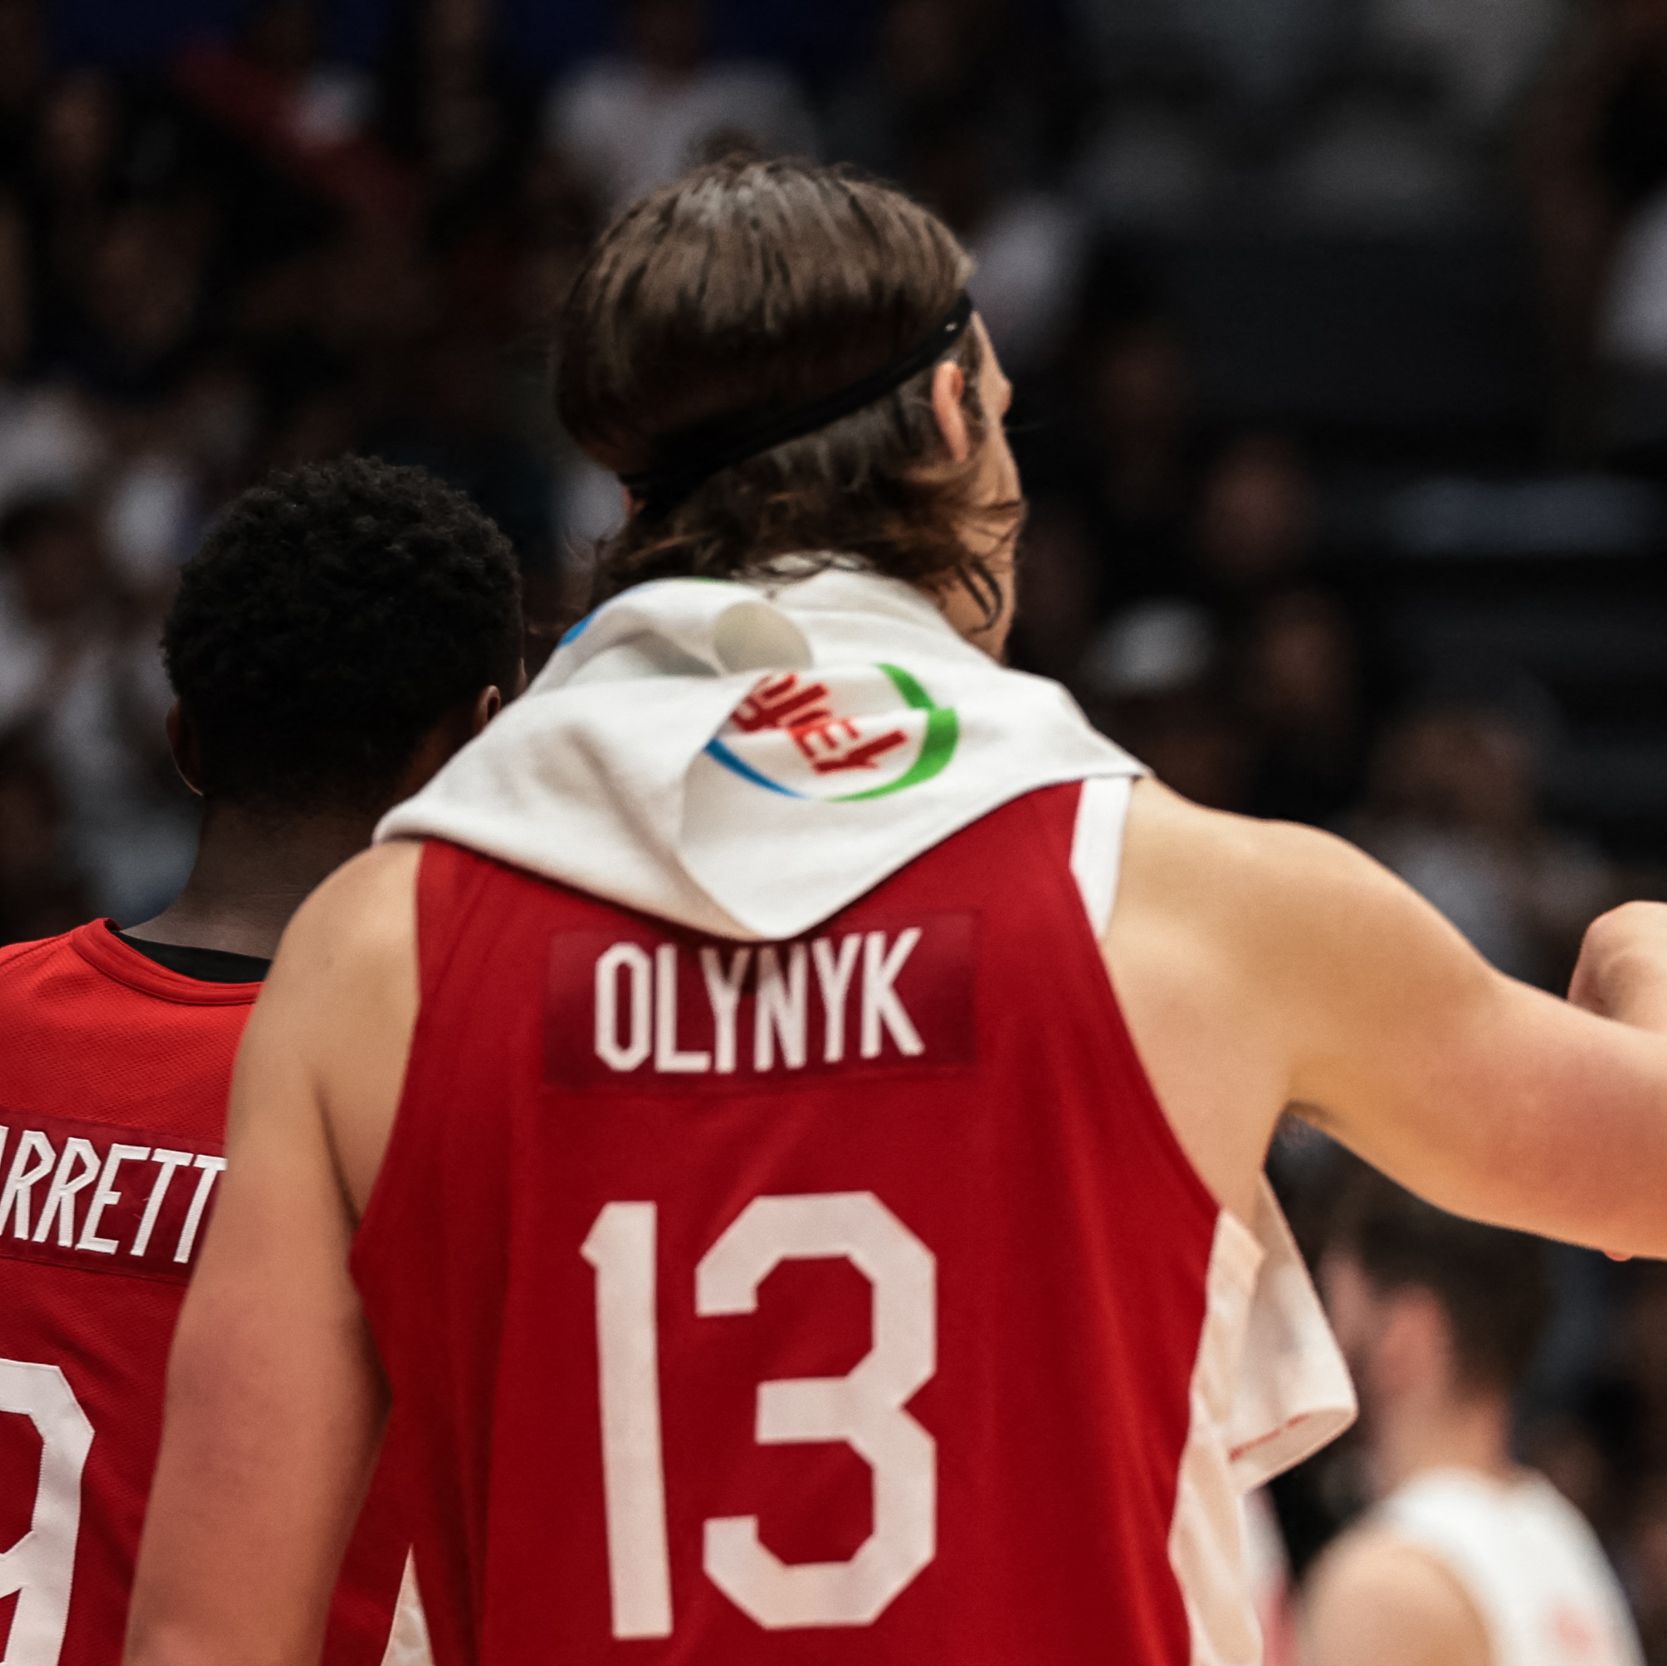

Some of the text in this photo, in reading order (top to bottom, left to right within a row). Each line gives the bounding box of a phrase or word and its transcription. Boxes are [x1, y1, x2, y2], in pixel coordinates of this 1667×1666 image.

[595, 926, 925, 1074] OLYNYK
[0, 1125, 228, 1264] RRETT
[581, 1191, 936, 1640] 13
